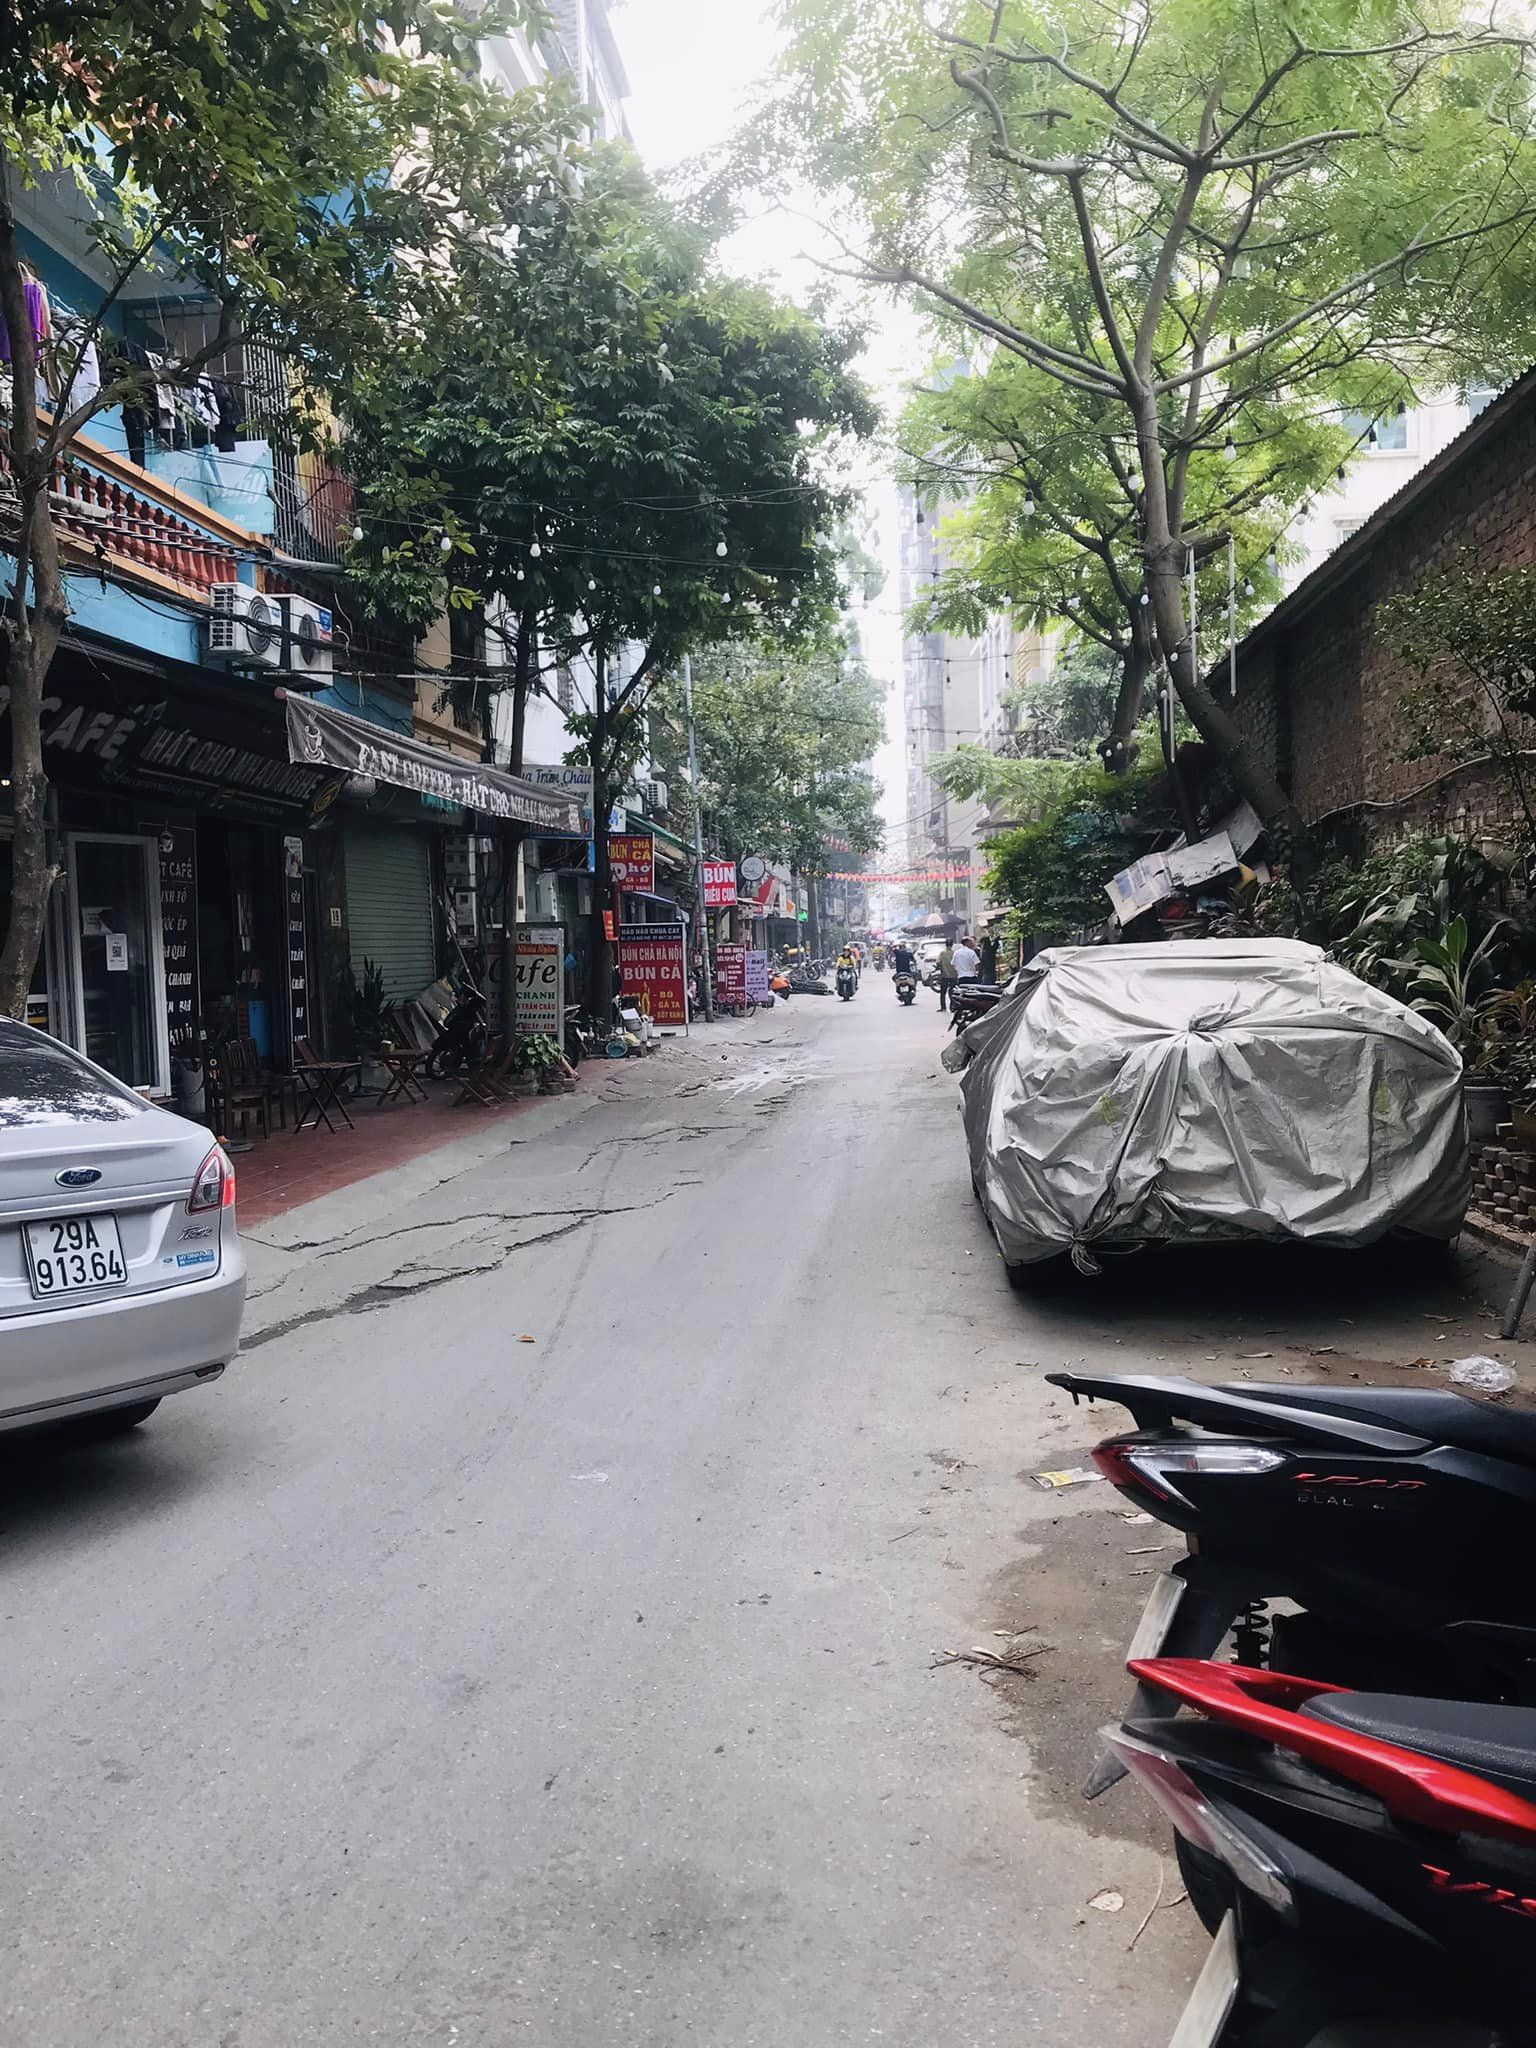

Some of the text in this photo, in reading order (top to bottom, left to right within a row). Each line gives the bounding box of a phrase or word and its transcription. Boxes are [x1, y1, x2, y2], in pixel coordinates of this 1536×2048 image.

[189, 740, 237, 777] CHO
[358, 742, 400, 776] FAST
[402, 759, 453, 798] COFFEE
[610, 840, 627, 859] BÚN
[704, 863, 734, 883] BÚN
[721, 888, 736, 902] CUA
[621, 945, 638, 961] BÚN
[638, 943, 656, 961] CHẢ
[656, 945, 667, 961] HÀ
[623, 964, 656, 981] BÚN
[515, 991, 555, 1000] CHANH
[68, 1170, 94, 1183] Ford
[50, 1219, 100, 1253] 29A
[36, 1250, 123, 1289] 913.64
